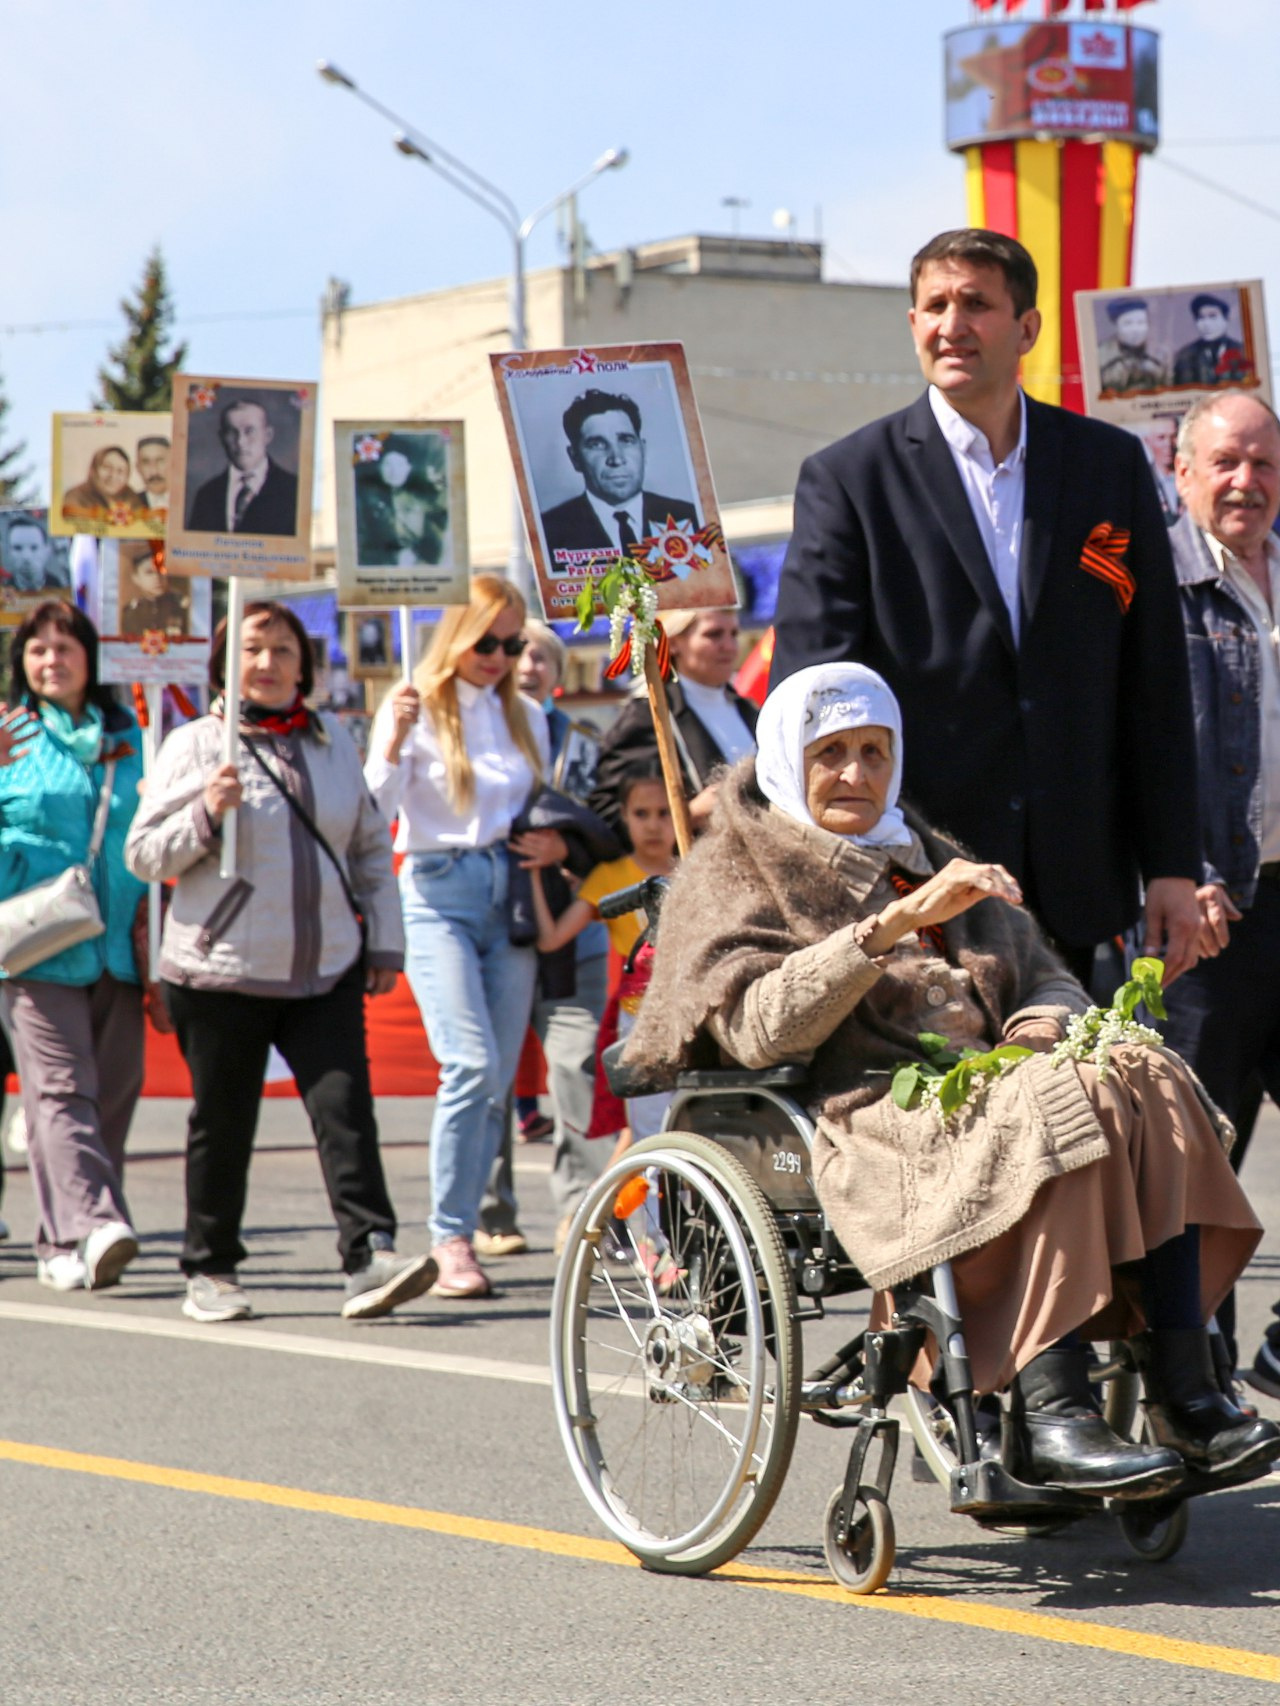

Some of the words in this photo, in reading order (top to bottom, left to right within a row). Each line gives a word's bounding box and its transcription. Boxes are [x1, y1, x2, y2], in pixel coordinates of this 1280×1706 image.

[596, 360, 630, 374] полк
[555, 548, 621, 563] Муртазин
[772, 1151, 802, 1174] 2294
